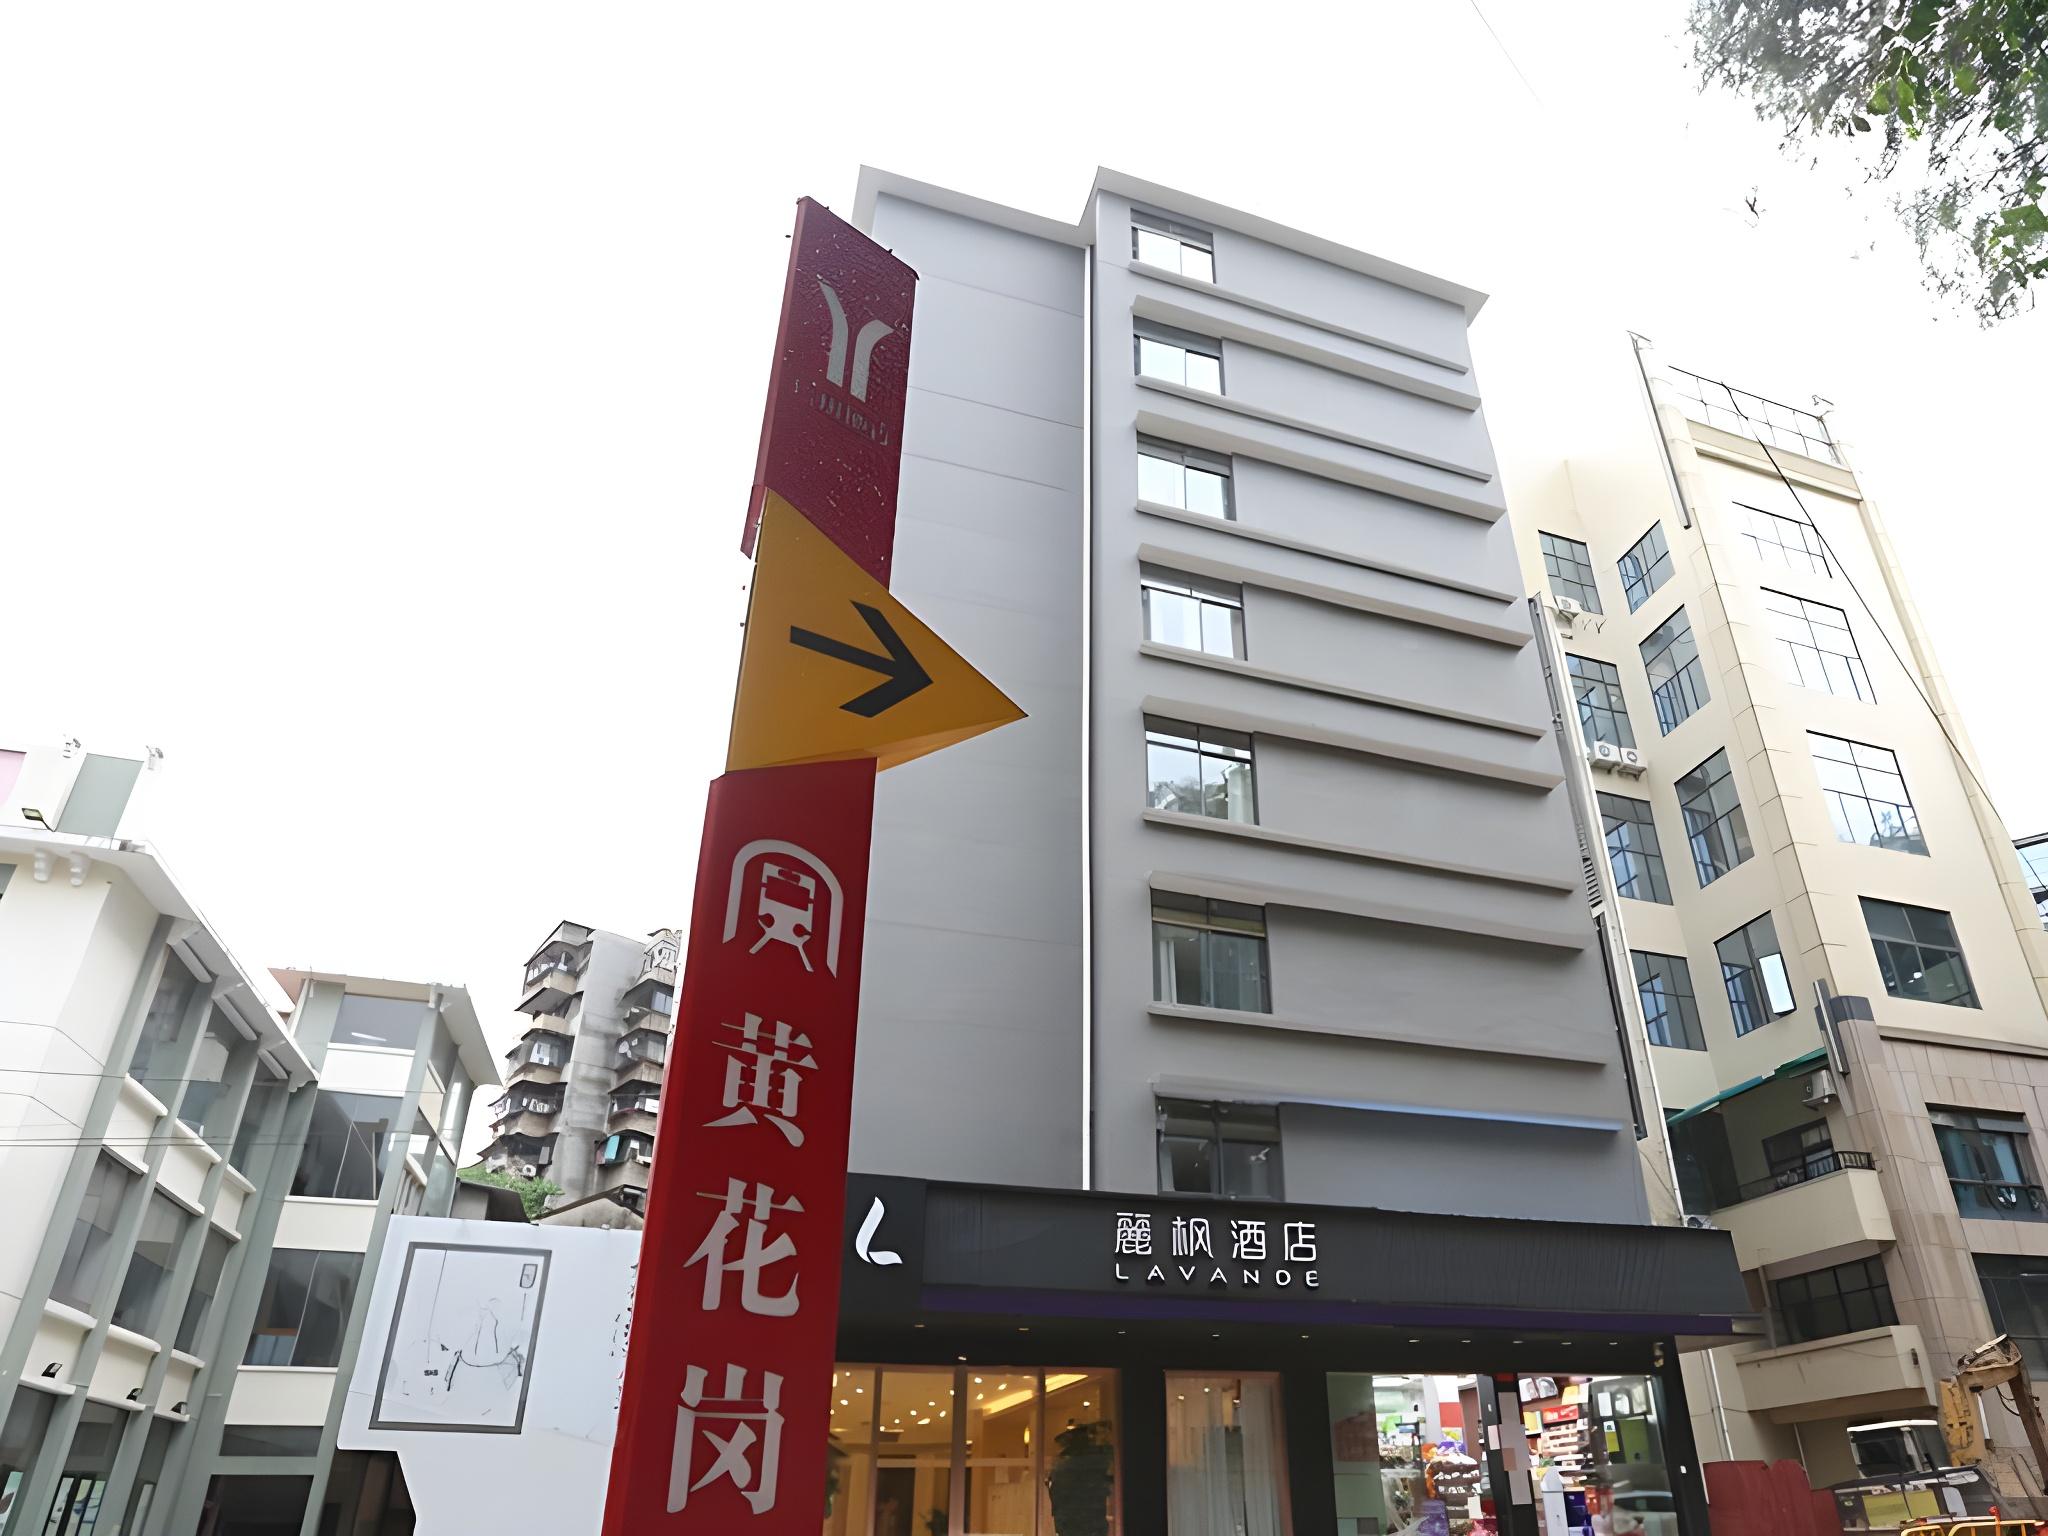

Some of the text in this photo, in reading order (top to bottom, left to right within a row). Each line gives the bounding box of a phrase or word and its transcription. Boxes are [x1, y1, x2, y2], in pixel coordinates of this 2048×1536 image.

[1114, 1211, 1318, 1262] 麗枫酒店
[667, 1013, 818, 1517] 黄花岗
[1114, 1262, 1320, 1287] LAVANDE
